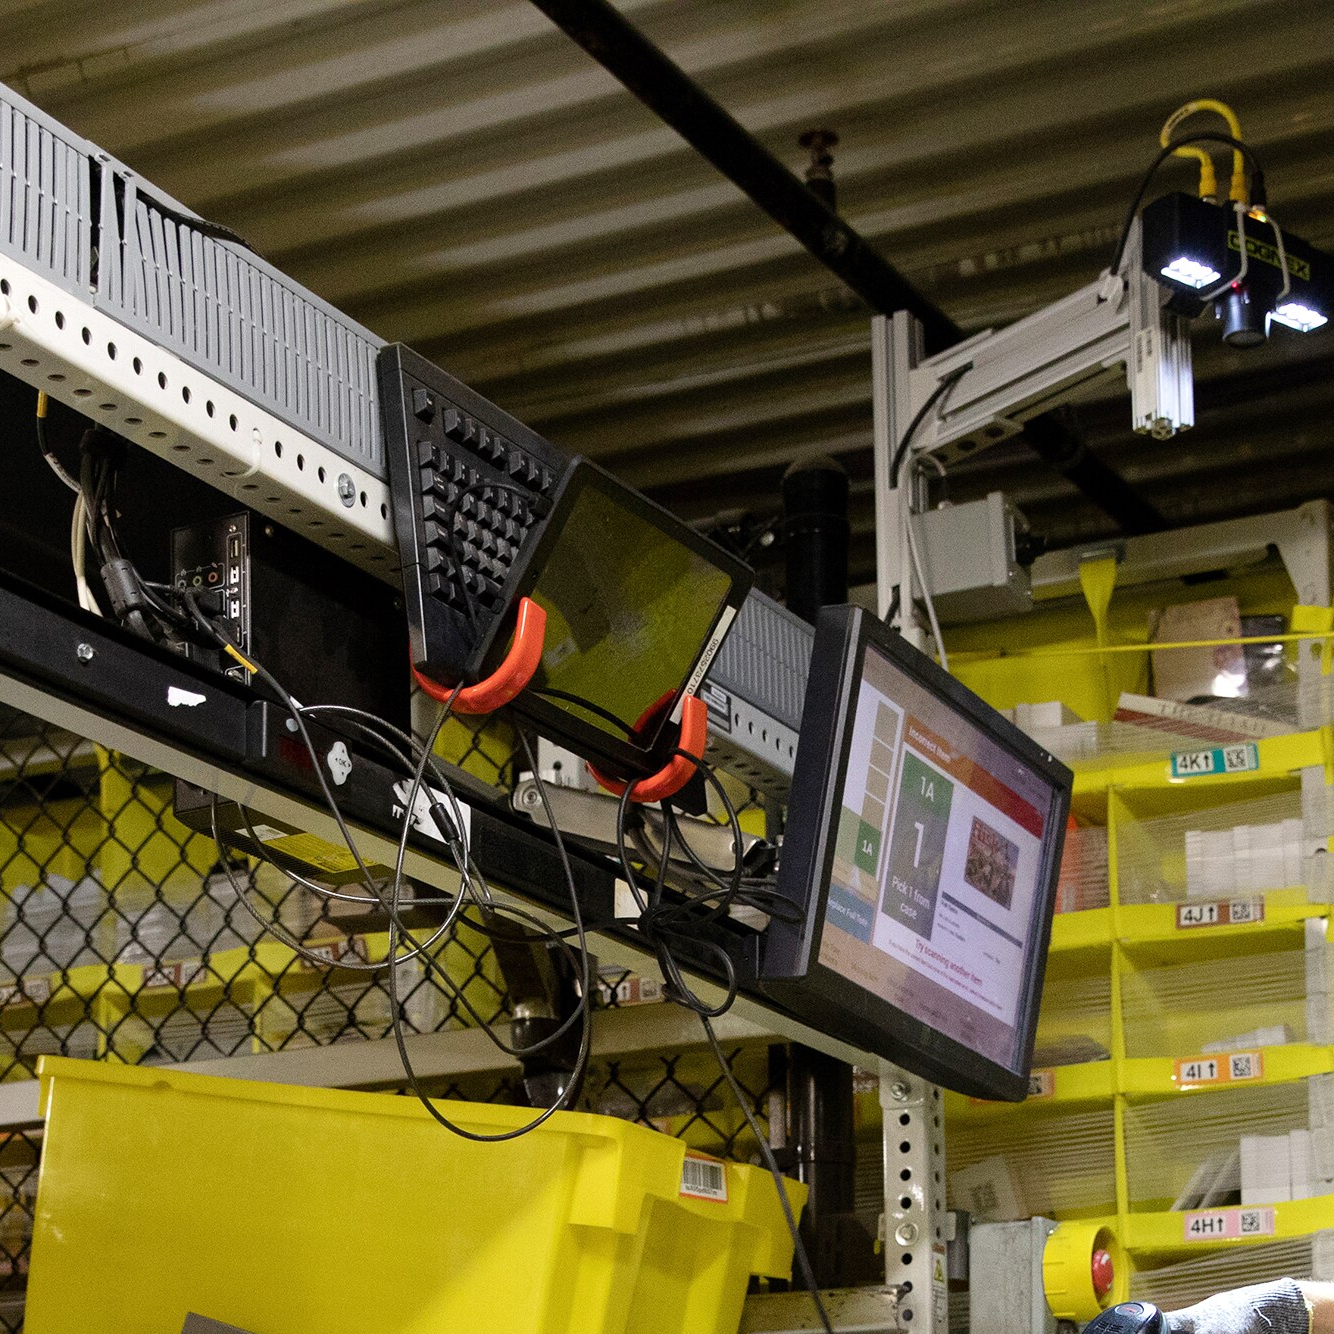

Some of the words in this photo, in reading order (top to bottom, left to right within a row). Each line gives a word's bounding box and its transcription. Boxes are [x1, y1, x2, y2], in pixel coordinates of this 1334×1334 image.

[1178, 752, 1199, 770] 4K
[921, 776, 935, 802] 1A
[862, 839, 873, 857] 1A
[914, 821, 925, 870] 1
[892, 874, 907, 896] Pick
[914, 889, 930, 910] from
[900, 902, 917, 921] case
[1183, 908, 1202, 921] 4J
[924, 945, 948, 969] scanning
[1191, 1217, 1214, 1233] 4H
